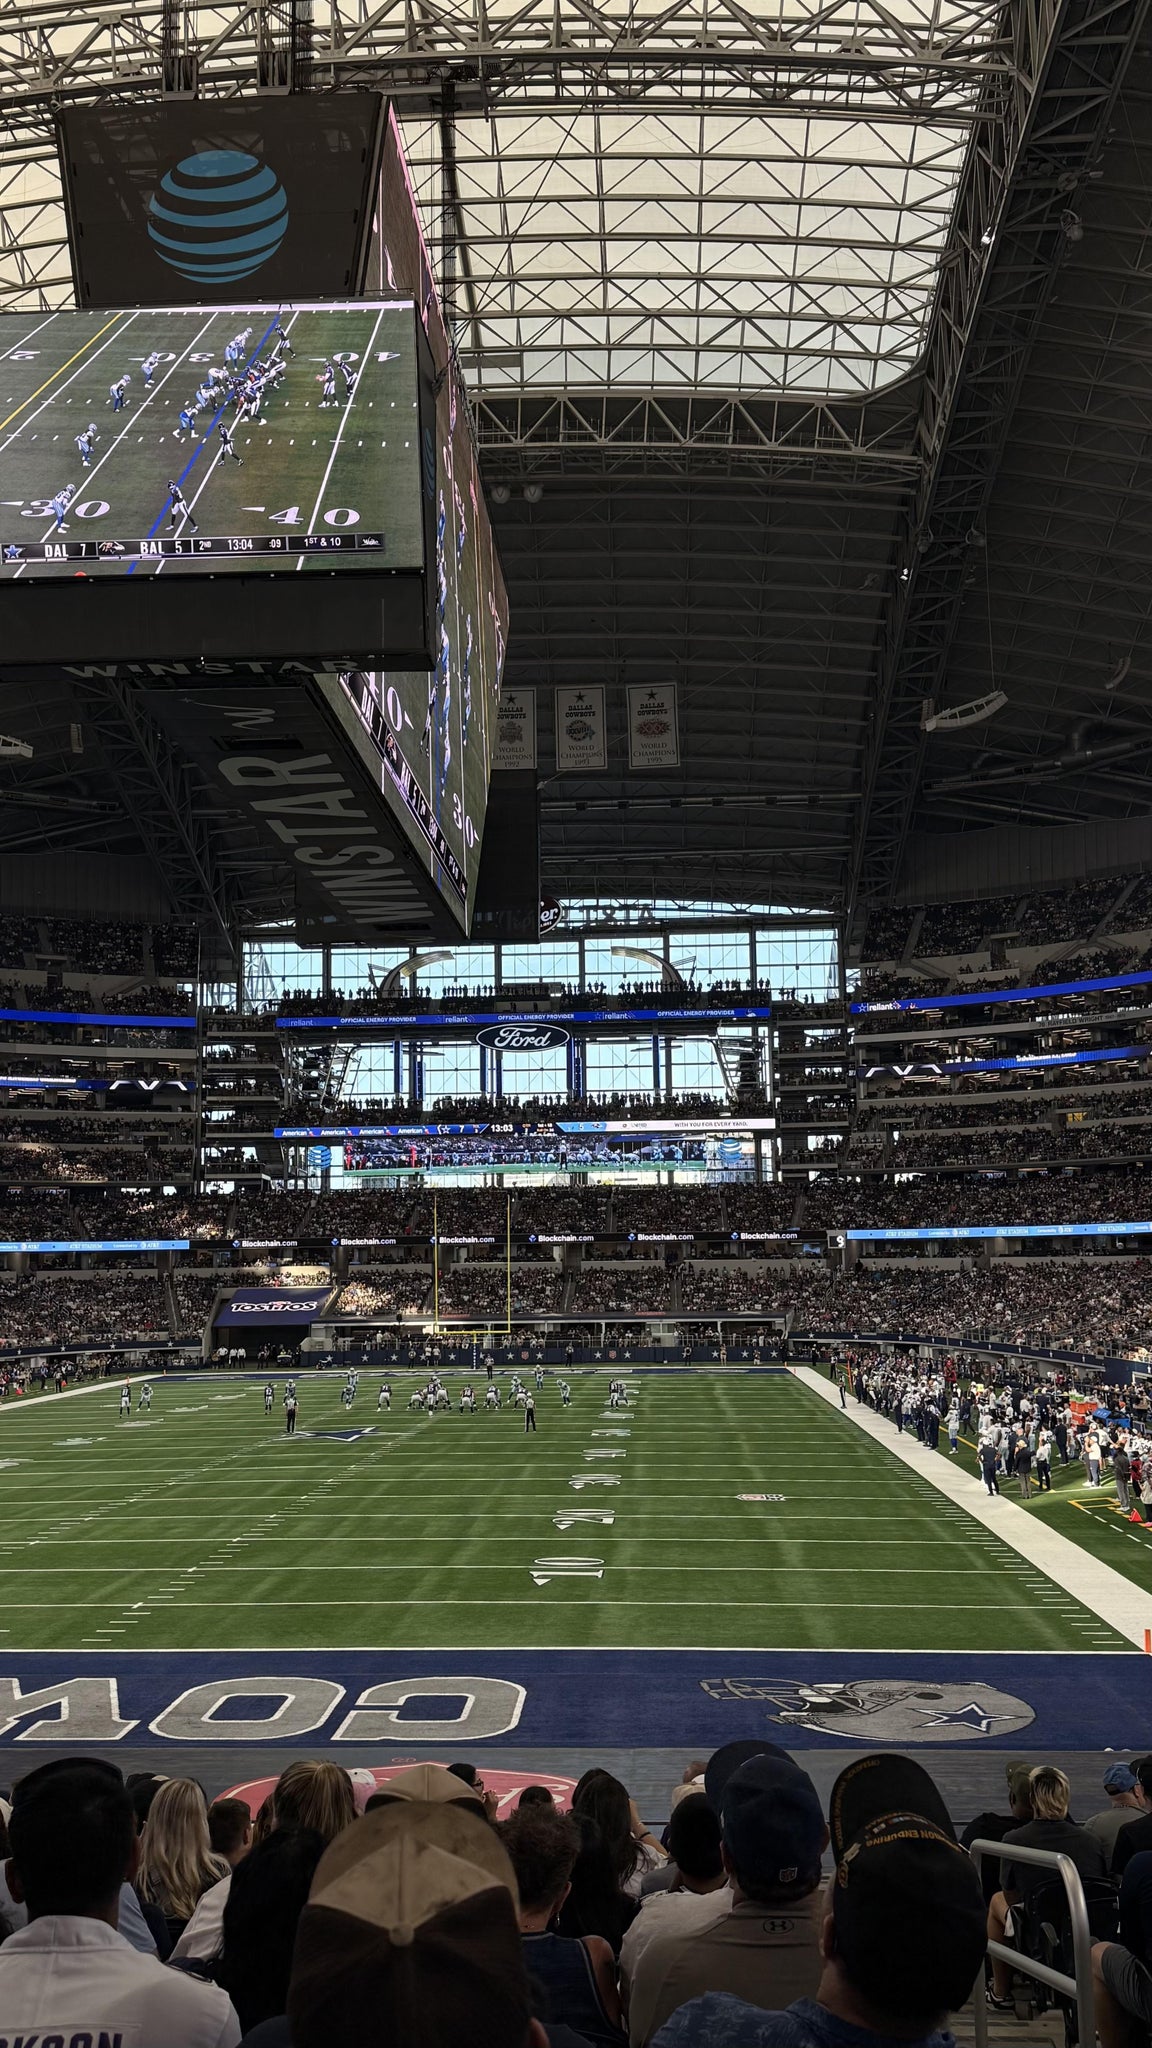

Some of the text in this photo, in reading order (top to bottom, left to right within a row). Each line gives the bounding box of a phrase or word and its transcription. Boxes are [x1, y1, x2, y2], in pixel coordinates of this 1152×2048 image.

[268, 506, 360, 526] 40
[44, 544, 69, 558] DAL
[80, 544, 86, 556] 7
[140, 541, 165, 554] BAL
[175, 541, 182, 554] 5
[227, 539, 253, 551] 13:04
[304, 537, 318, 548] 1ST
[320, 537, 327, 546] &
[330, 536, 341, 546] 10
[217, 753, 434, 924] WINSTAR
[604, 1012, 628, 1020] reliant
[494, 1027, 552, 1048] Ford
[490, 1124, 513, 1132] 13:03
[439, 1236, 495, 1244] Blockchain.com
[538, 1234, 594, 1242] Blockchain.com
[740, 1232, 798, 1240] Blockchain.com
